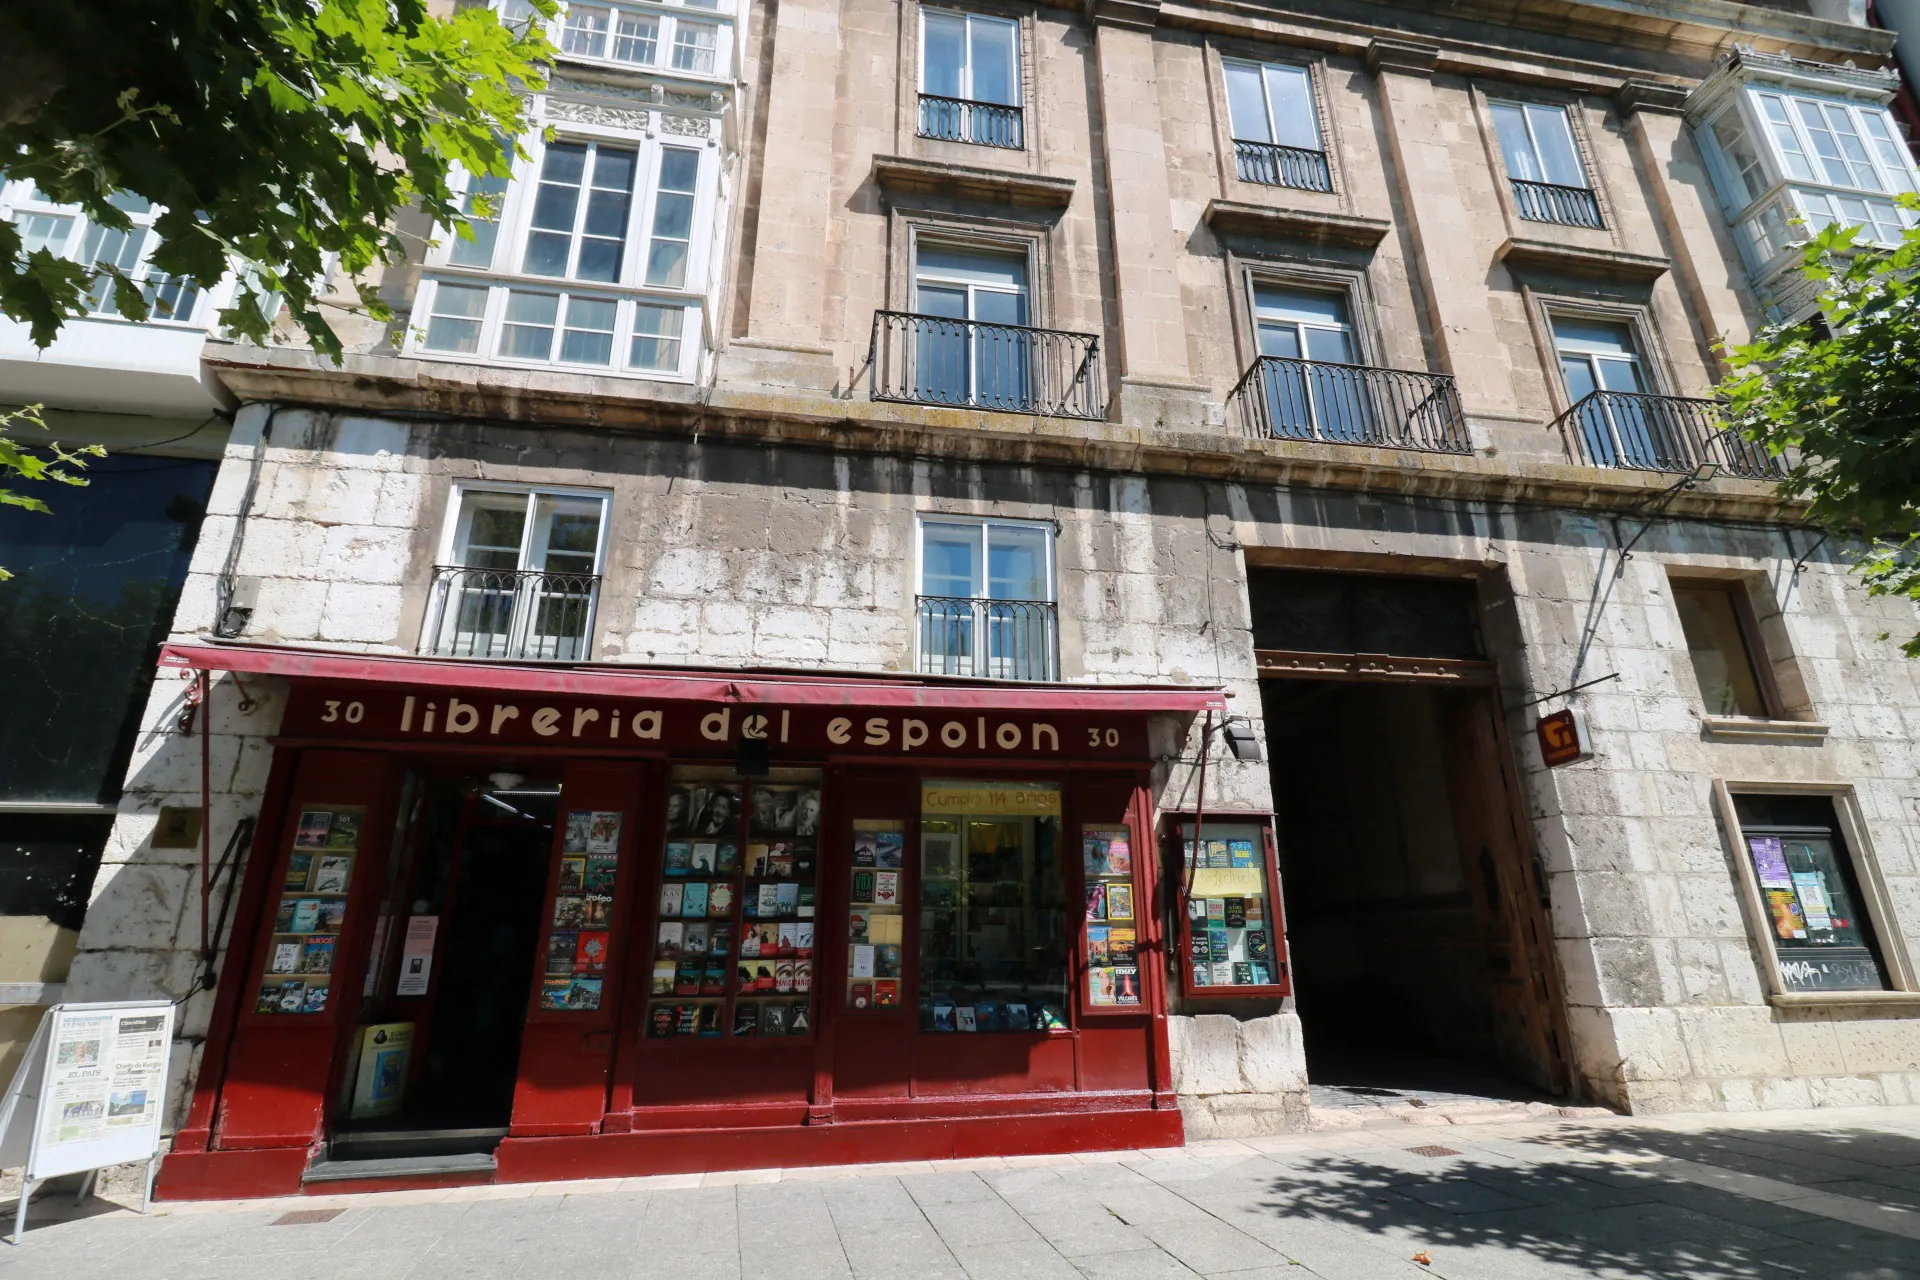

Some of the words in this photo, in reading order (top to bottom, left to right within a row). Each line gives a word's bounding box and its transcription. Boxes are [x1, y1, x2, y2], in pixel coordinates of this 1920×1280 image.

[321, 700, 365, 724] 30
[399, 695, 664, 740] libreria
[700, 706, 790, 744] del
[826, 715, 1061, 752] espolon
[1087, 726, 1120, 749] 30
[855, 875, 872, 890] VOX
